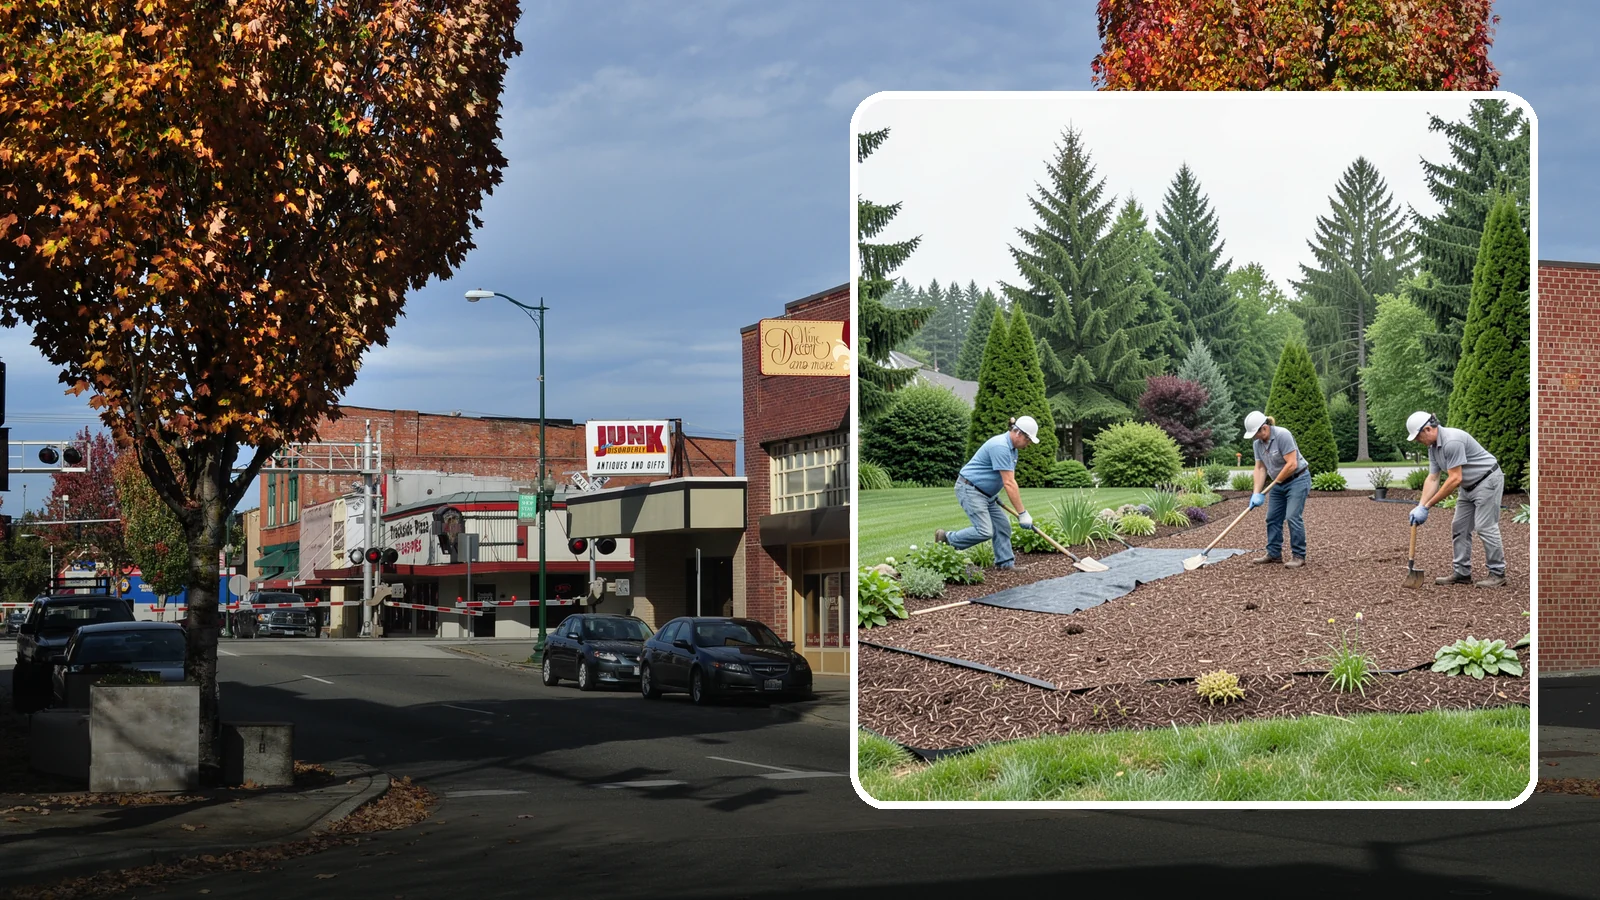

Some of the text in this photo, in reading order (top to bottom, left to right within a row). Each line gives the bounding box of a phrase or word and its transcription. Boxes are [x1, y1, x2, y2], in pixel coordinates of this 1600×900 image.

[595, 425, 665, 457] JUNK
[607, 446, 646, 454] DISORDERLY
[596, 460, 665, 470] ANTIQUES AND GIFTS
[415, 519, 429, 535] Pizza
